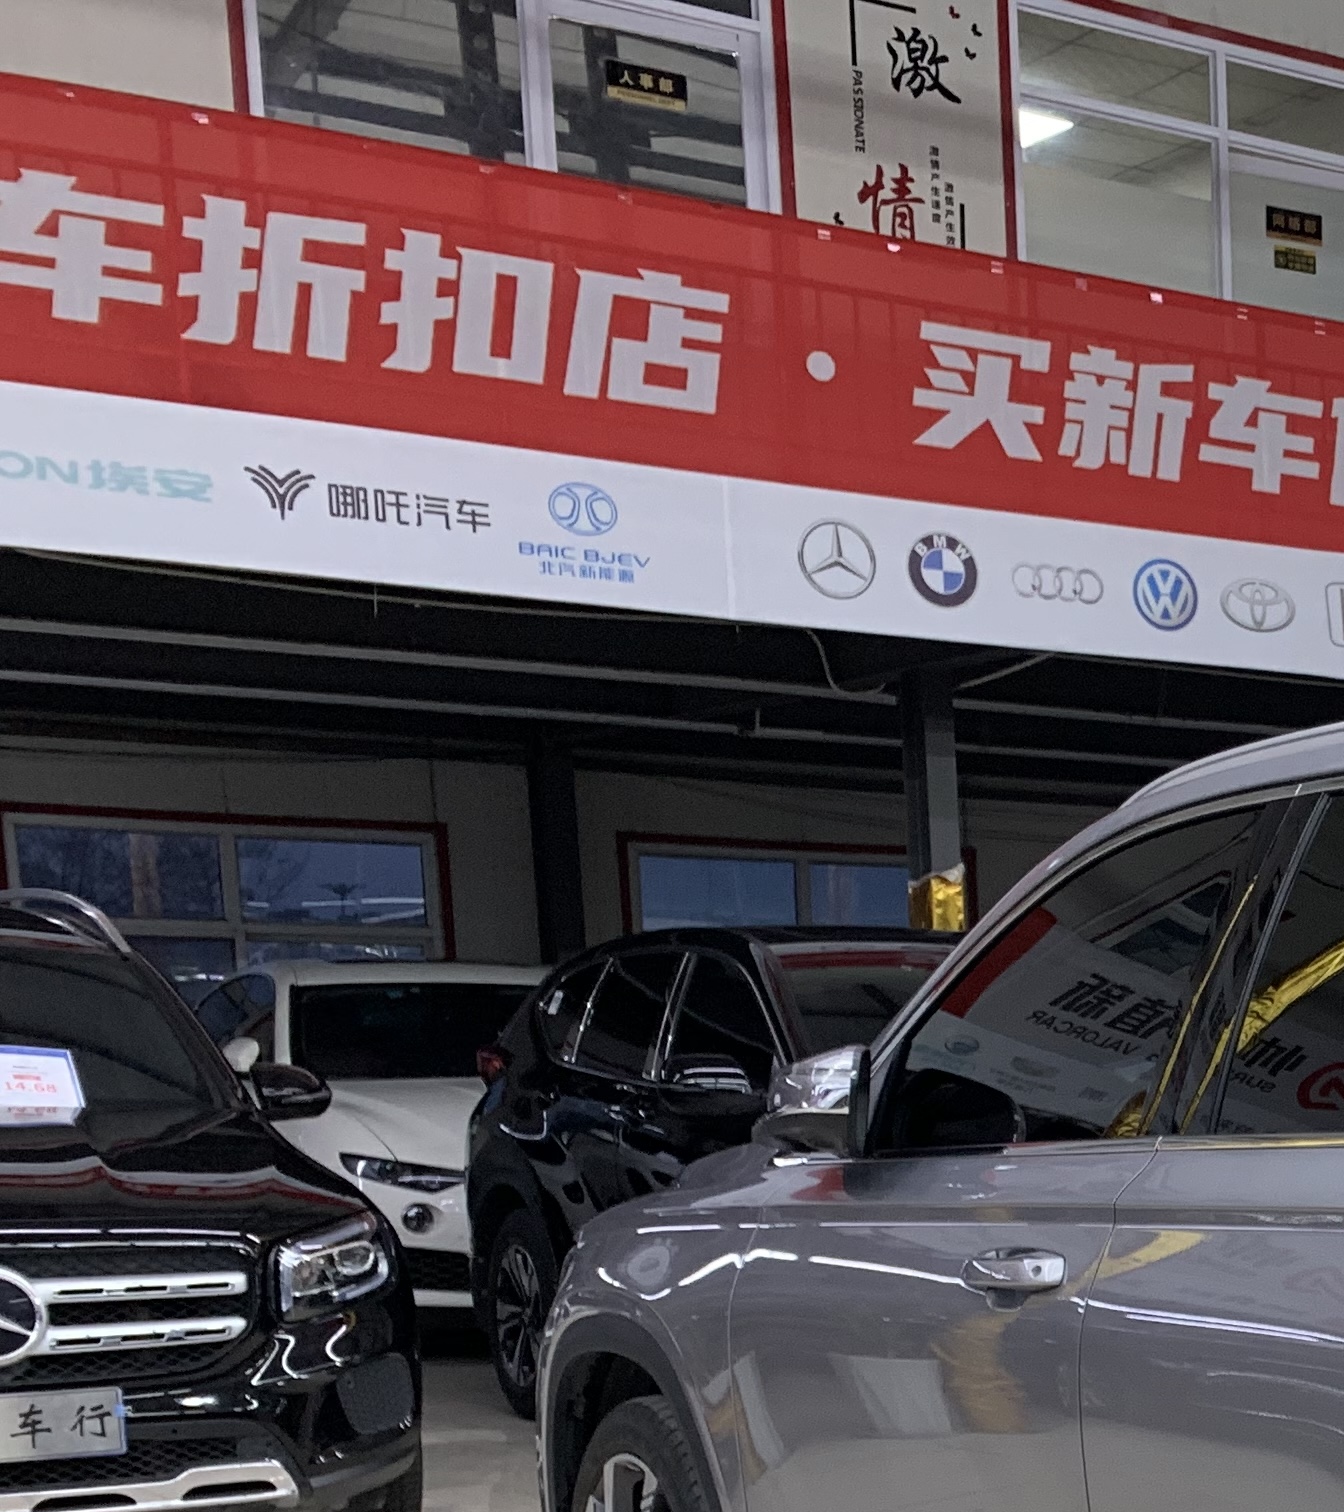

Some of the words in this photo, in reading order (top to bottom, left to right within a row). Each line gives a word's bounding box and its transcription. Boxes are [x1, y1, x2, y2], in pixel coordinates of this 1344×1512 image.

[0, 168, 731, 415] 车折扣店
[518, 541, 577, 560] BAIC
[583, 549, 651, 568] BJEV
[914, 534, 970, 562] BMW
[10, 1404, 112, 1449] 车行
